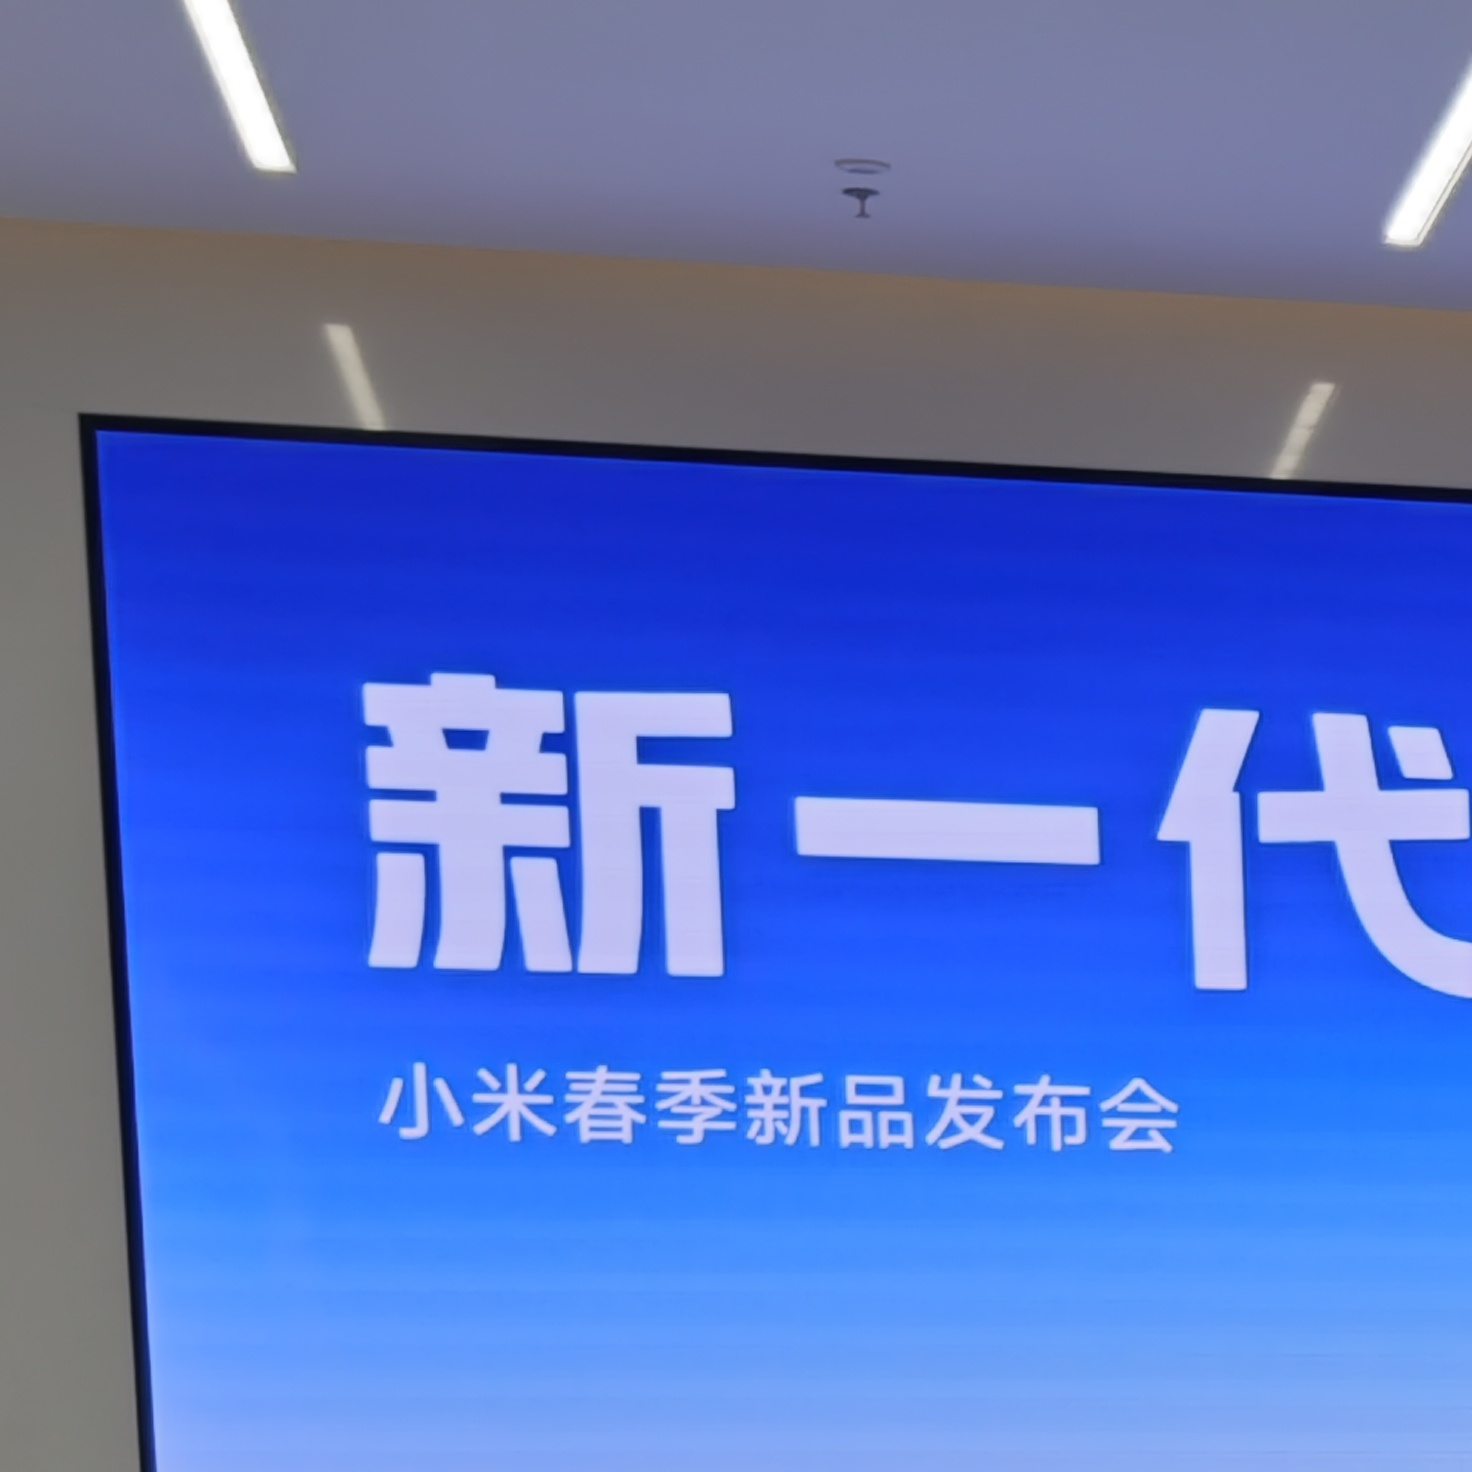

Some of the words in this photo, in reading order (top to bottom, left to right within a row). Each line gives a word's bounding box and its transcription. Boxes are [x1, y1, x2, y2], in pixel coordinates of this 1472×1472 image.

[378, 1060, 1180, 1153] 小米春季新品发布会
